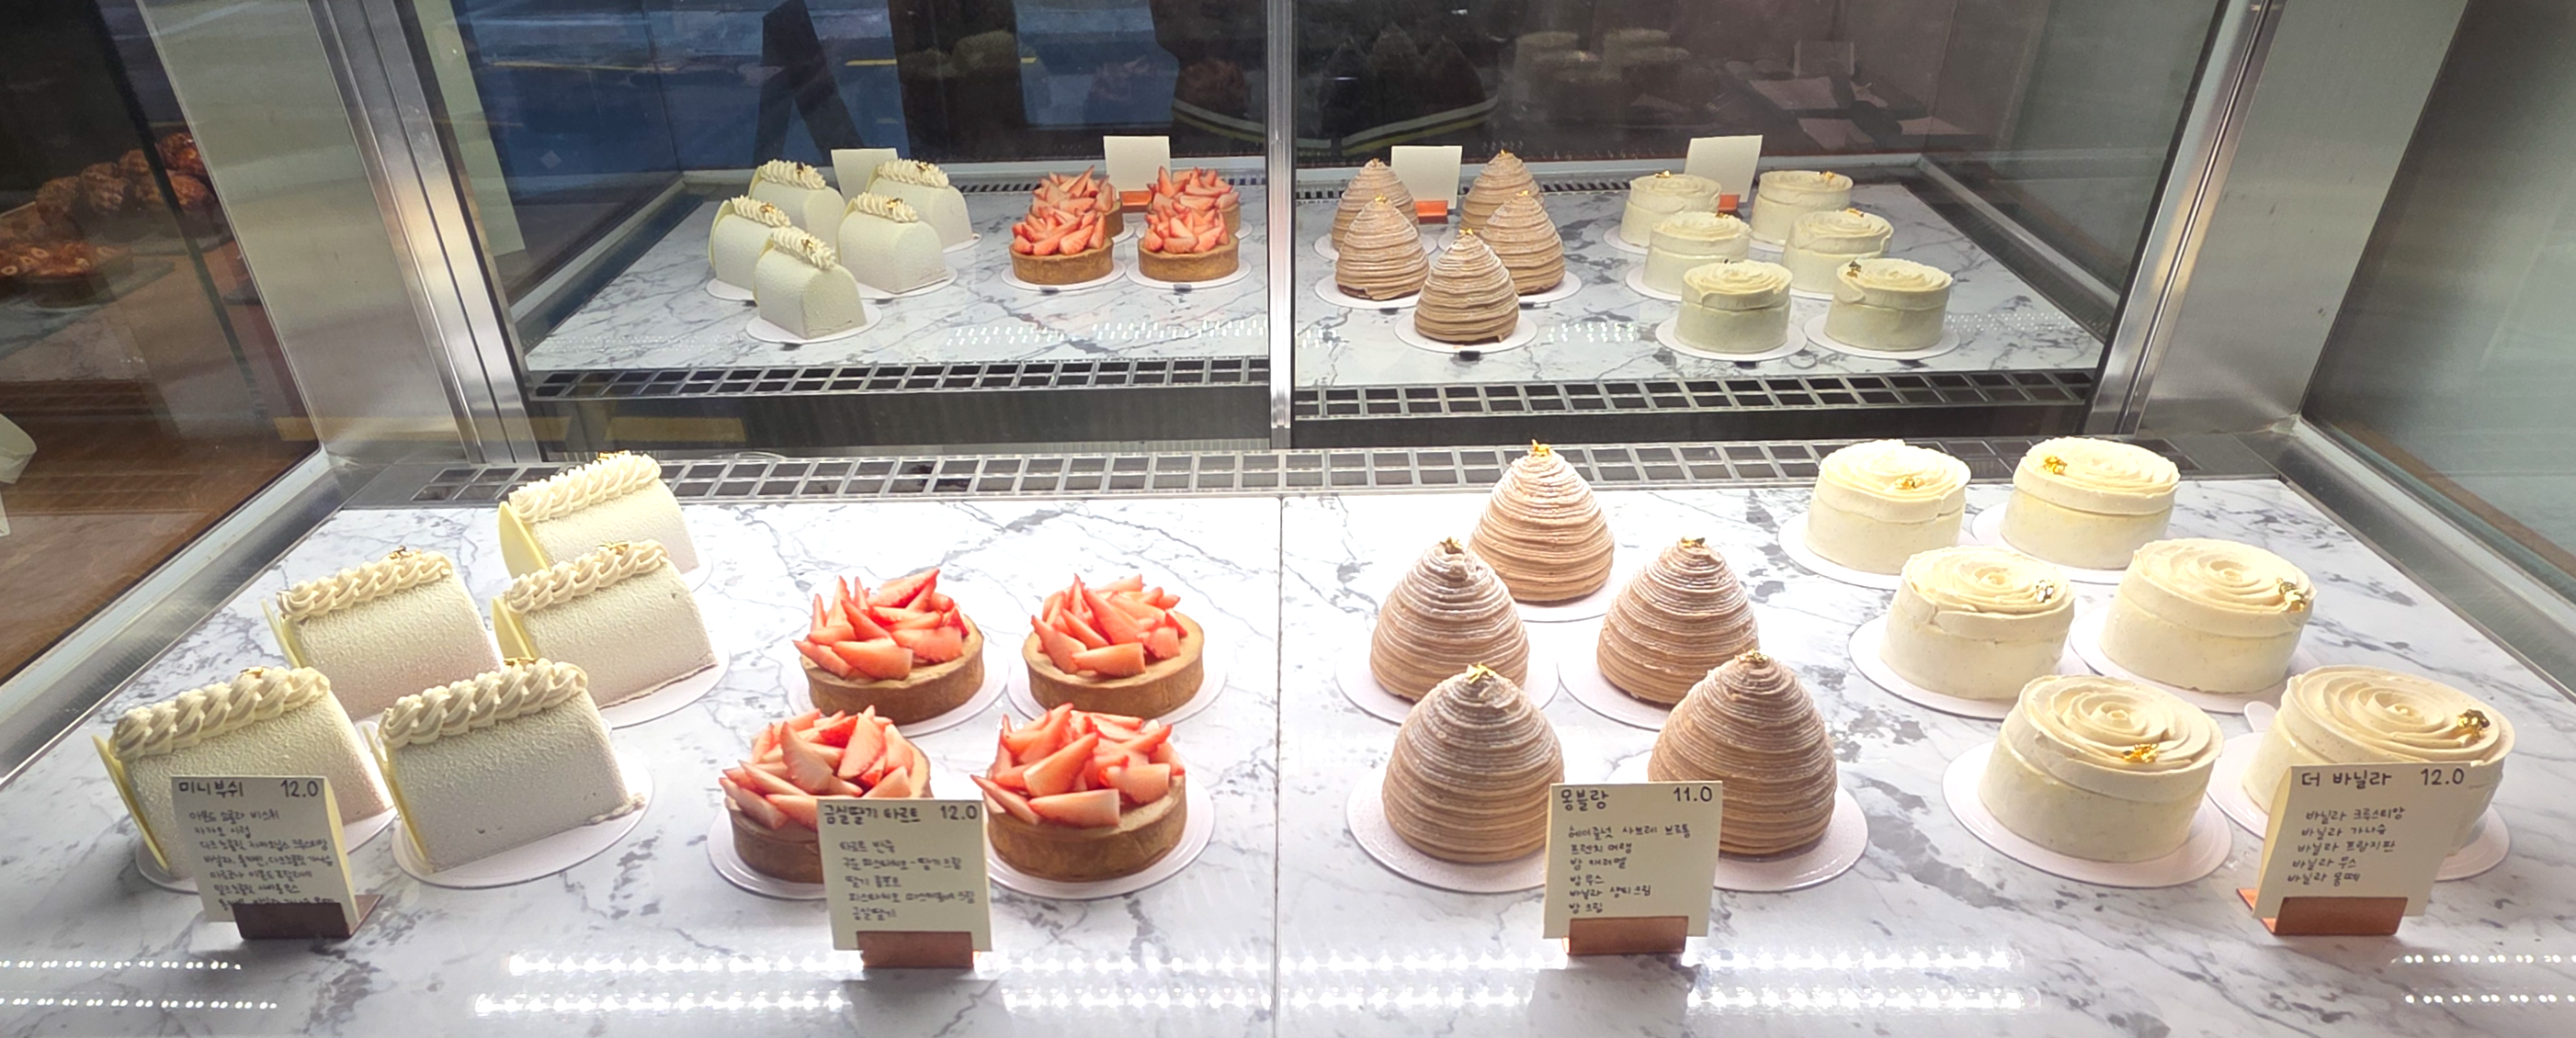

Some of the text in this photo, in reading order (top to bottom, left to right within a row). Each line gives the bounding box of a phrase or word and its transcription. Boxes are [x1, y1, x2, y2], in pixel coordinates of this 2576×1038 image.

[2300, 768, 2466, 790] 더 바닐라 12.0
[280, 779, 319, 798] 12.0
[1560, 785, 1713, 812] 몽블랑 11.0
[823, 804, 979, 826] 금실딸기 타르트 12.0
[2305, 806, 2407, 825] 바닐라 크루스티앙
[1568, 825, 1614, 841] 헤이즐넛
[1622, 824, 1658, 836] 사브레
[2300, 823, 2388, 841] 바닐라 가나슈
[839, 840, 868, 852] 타르트
[1571, 843, 1604, 855] 프렌치
[2297, 840, 2397, 856] 바닐라 프랑지판
[1570, 856, 1583, 871] 밤
[2292, 855, 2357, 872] 바닐라 무스
[845, 875, 870, 889] 딸기
[1569, 874, 1606, 887] 밤 무스
[2287, 872, 2329, 886] 바닐라
[1569, 887, 1604, 900] 바닐라
[1568, 901, 1604, 915] 밤 크림
